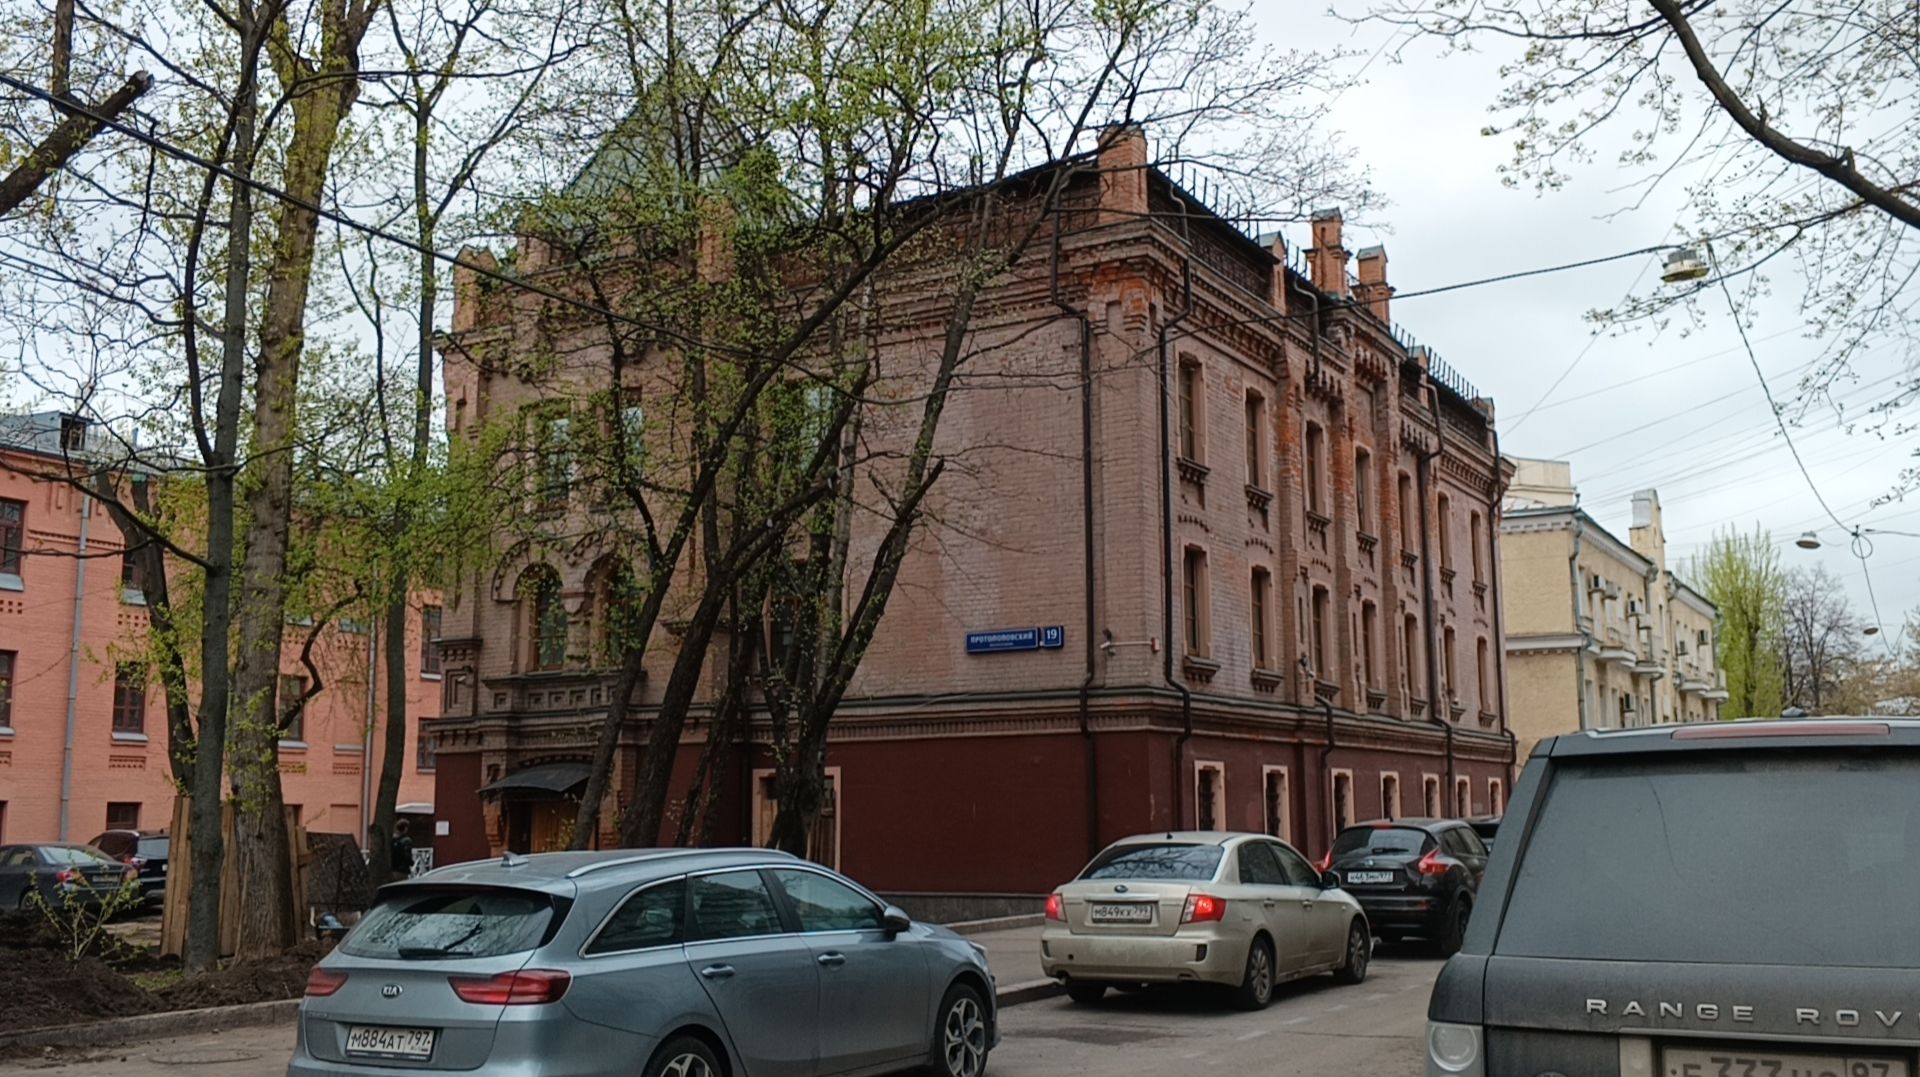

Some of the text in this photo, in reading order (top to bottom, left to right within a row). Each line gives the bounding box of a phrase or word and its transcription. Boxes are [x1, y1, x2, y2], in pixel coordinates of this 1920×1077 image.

[1046, 628, 1058, 640] 19
[1586, 998, 1920, 1027] RANGE ROV
